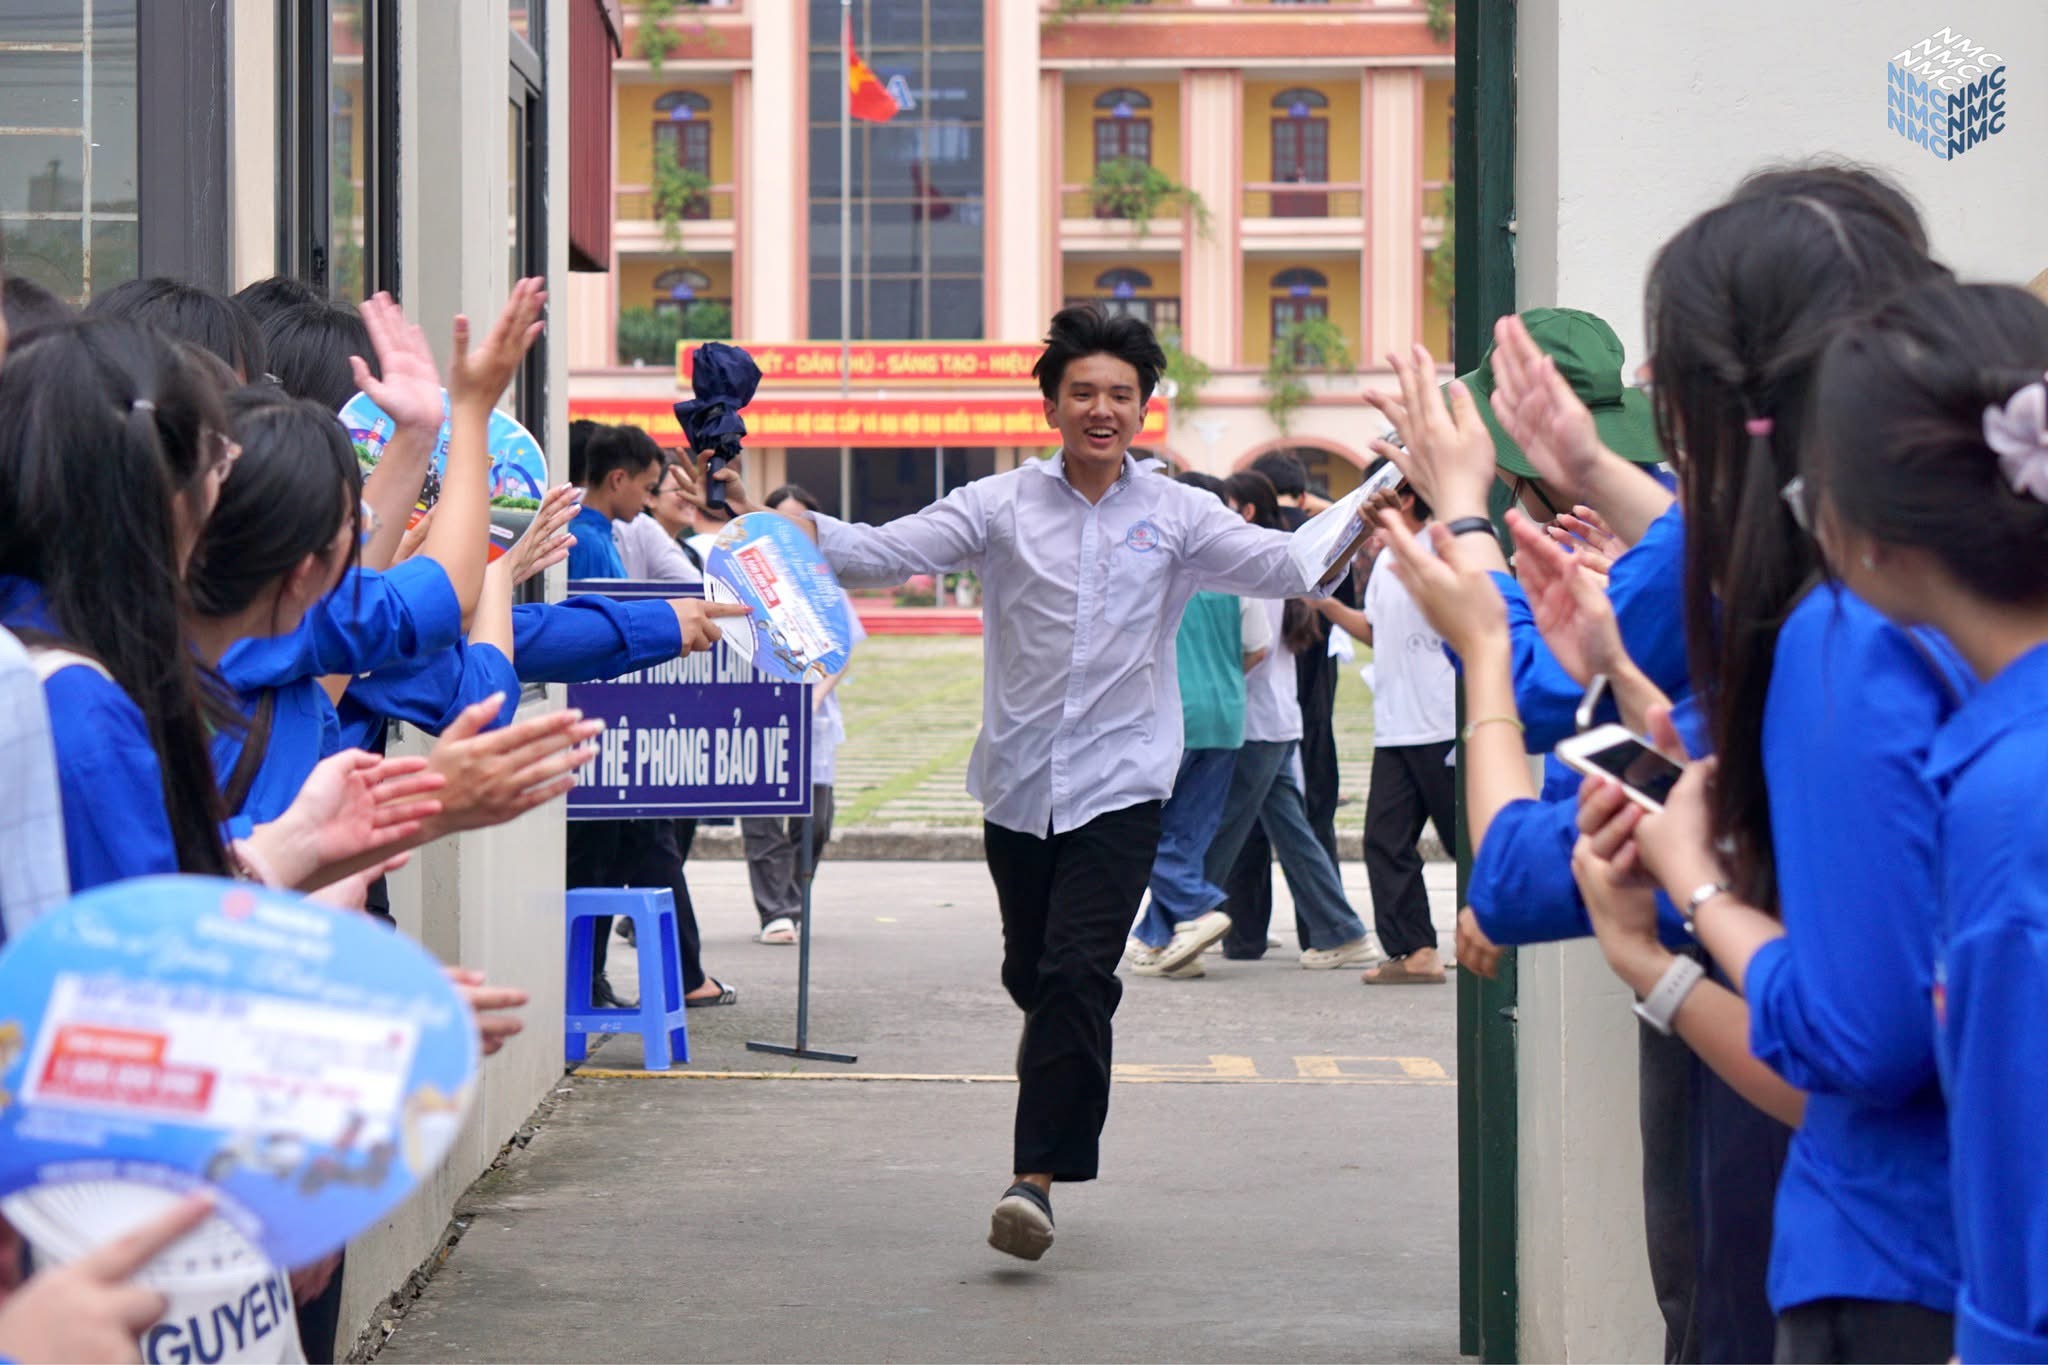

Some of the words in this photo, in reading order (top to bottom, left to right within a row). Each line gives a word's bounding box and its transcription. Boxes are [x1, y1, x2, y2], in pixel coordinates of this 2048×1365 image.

[886, 350, 938, 374] SÁNG
[941, 354, 977, 377] TẠO
[601, 716, 630, 800] HỆ
[635, 713, 710, 787] PHÒNG
[715, 707, 758, 785] BẢO
[763, 714, 790, 798] VỆ
[147, 1270, 289, 1365] GUYEN
